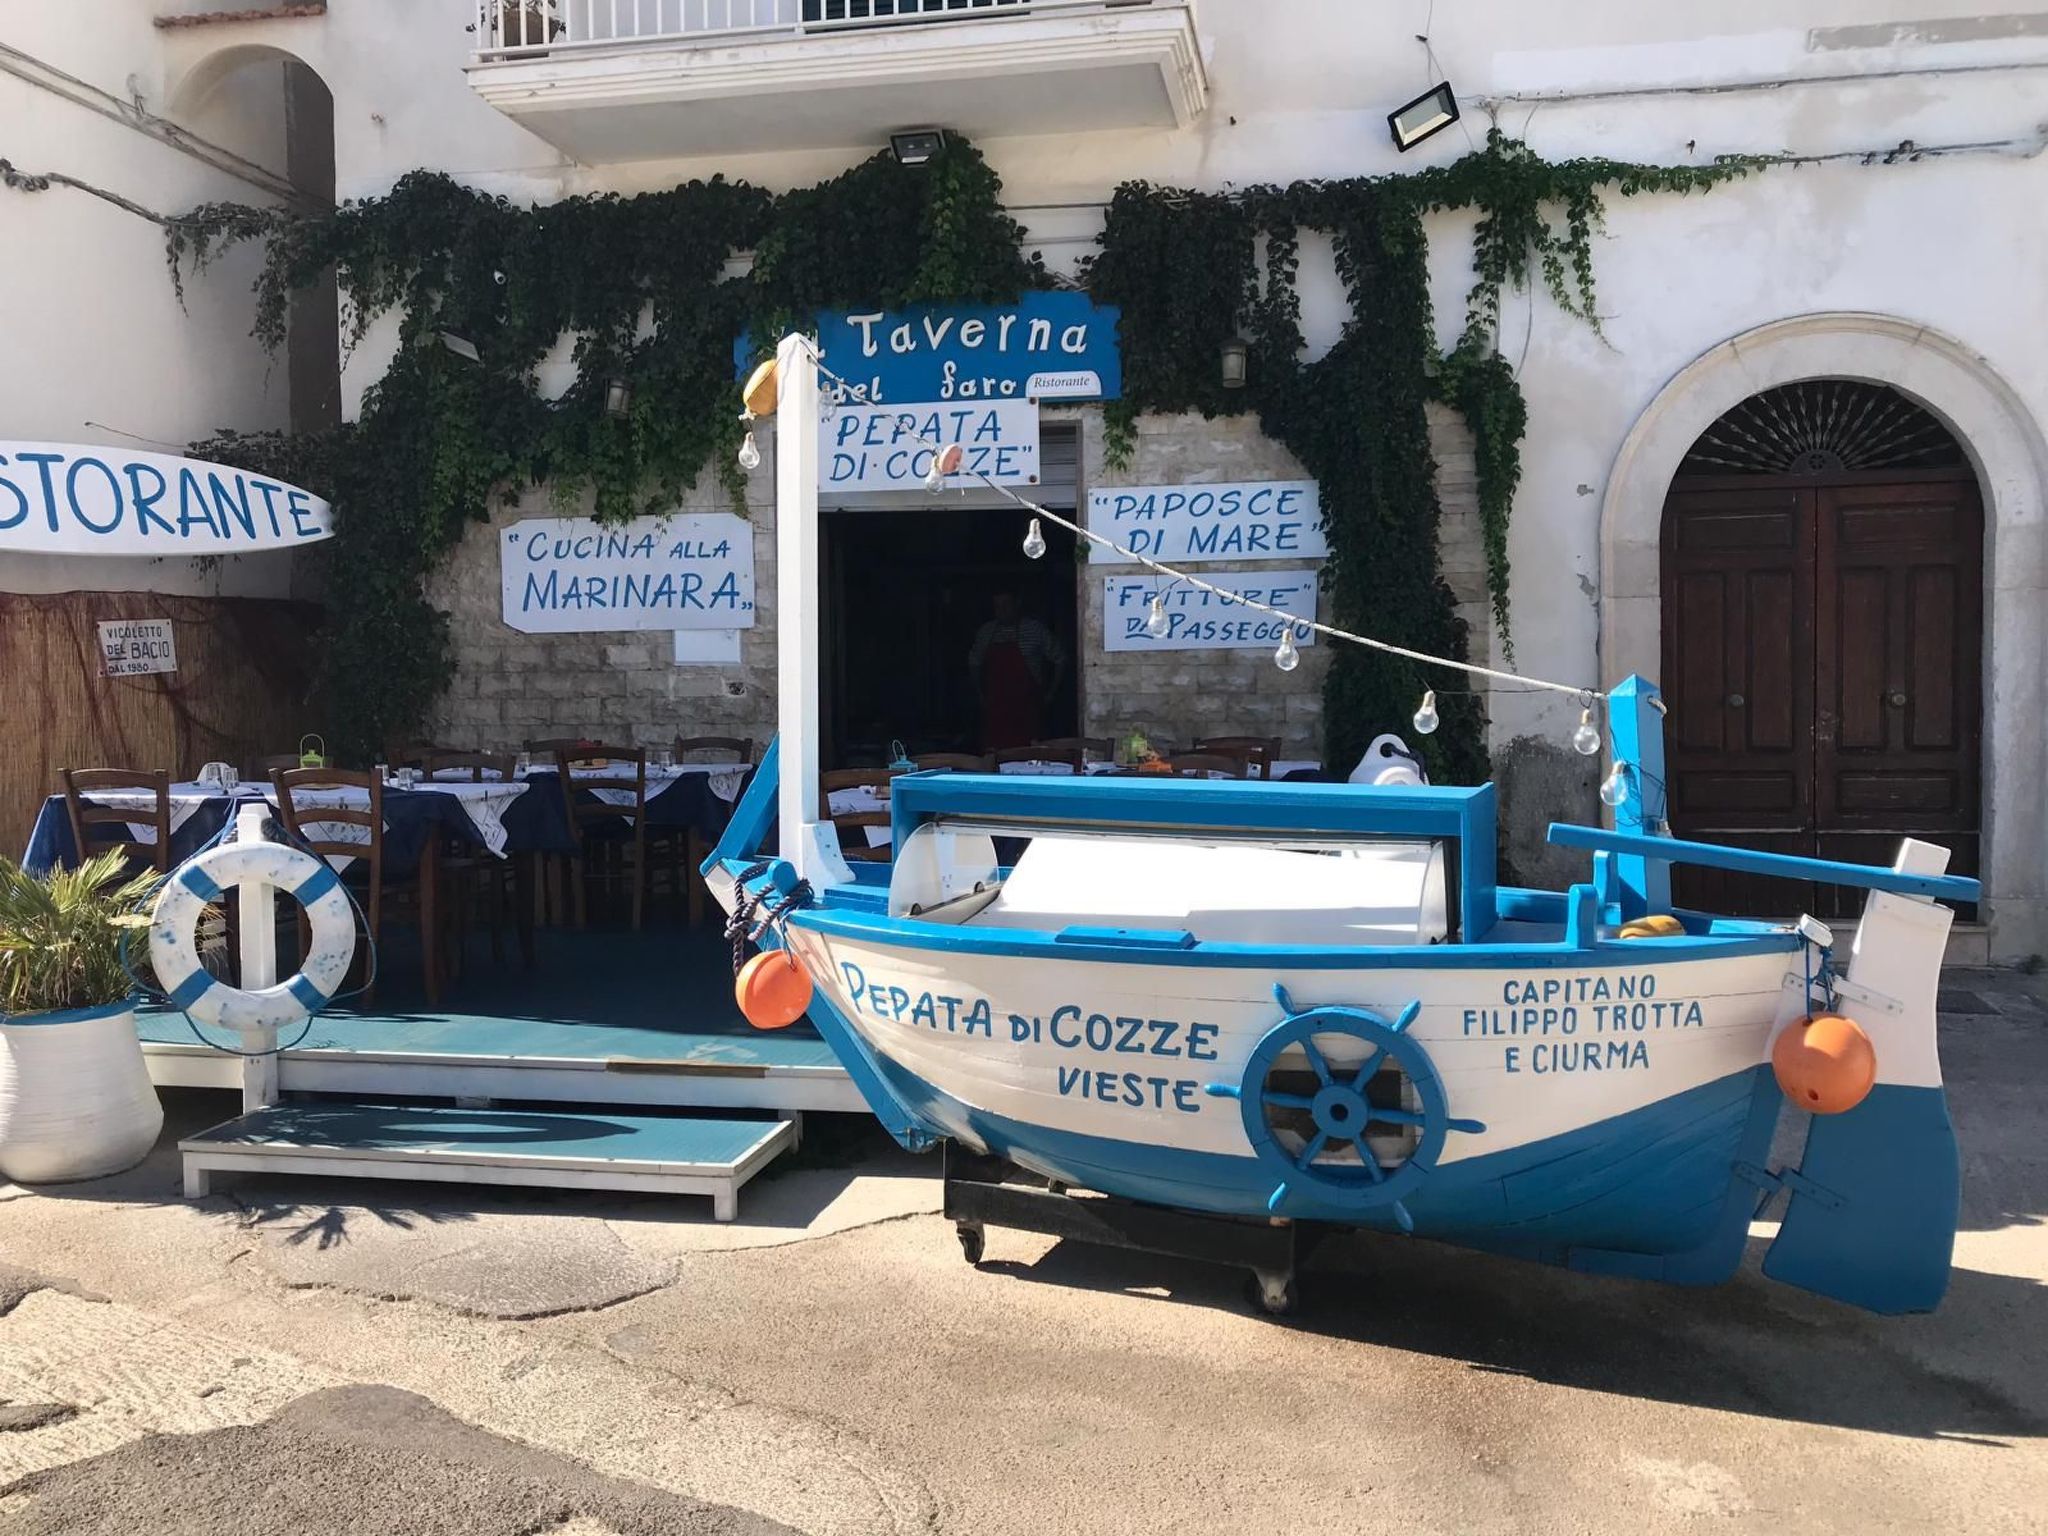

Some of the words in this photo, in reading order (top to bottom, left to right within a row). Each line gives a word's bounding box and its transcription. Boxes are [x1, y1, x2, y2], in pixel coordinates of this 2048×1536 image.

[846, 311, 1089, 358] Taverna
[1033, 375, 1090, 389] Ristorante
[1095, 488, 1304, 520] "PAPOSCE
[669, 540, 731, 559] ALLA
[1129, 529, 1165, 555] DI
[106, 626, 162, 639] VICOLETTO
[107, 643, 127, 655] DEL
[131, 641, 170, 659] BACIO
[109, 664, 126, 673] DAL
[1503, 974, 1656, 1005] CAPITANO
[840, 961, 992, 1038] PEPATA
[1008, 1014, 1041, 1043] DI
[1050, 1005, 1220, 1061] COZZE
[1463, 1006, 1578, 1036] FILIPPO
[1593, 1001, 1704, 1033] TROTTA
[1505, 1046, 1521, 1073] E
[1532, 1040, 1650, 1074] CIURMA
[1058, 1066, 1201, 1112] VIESTE
